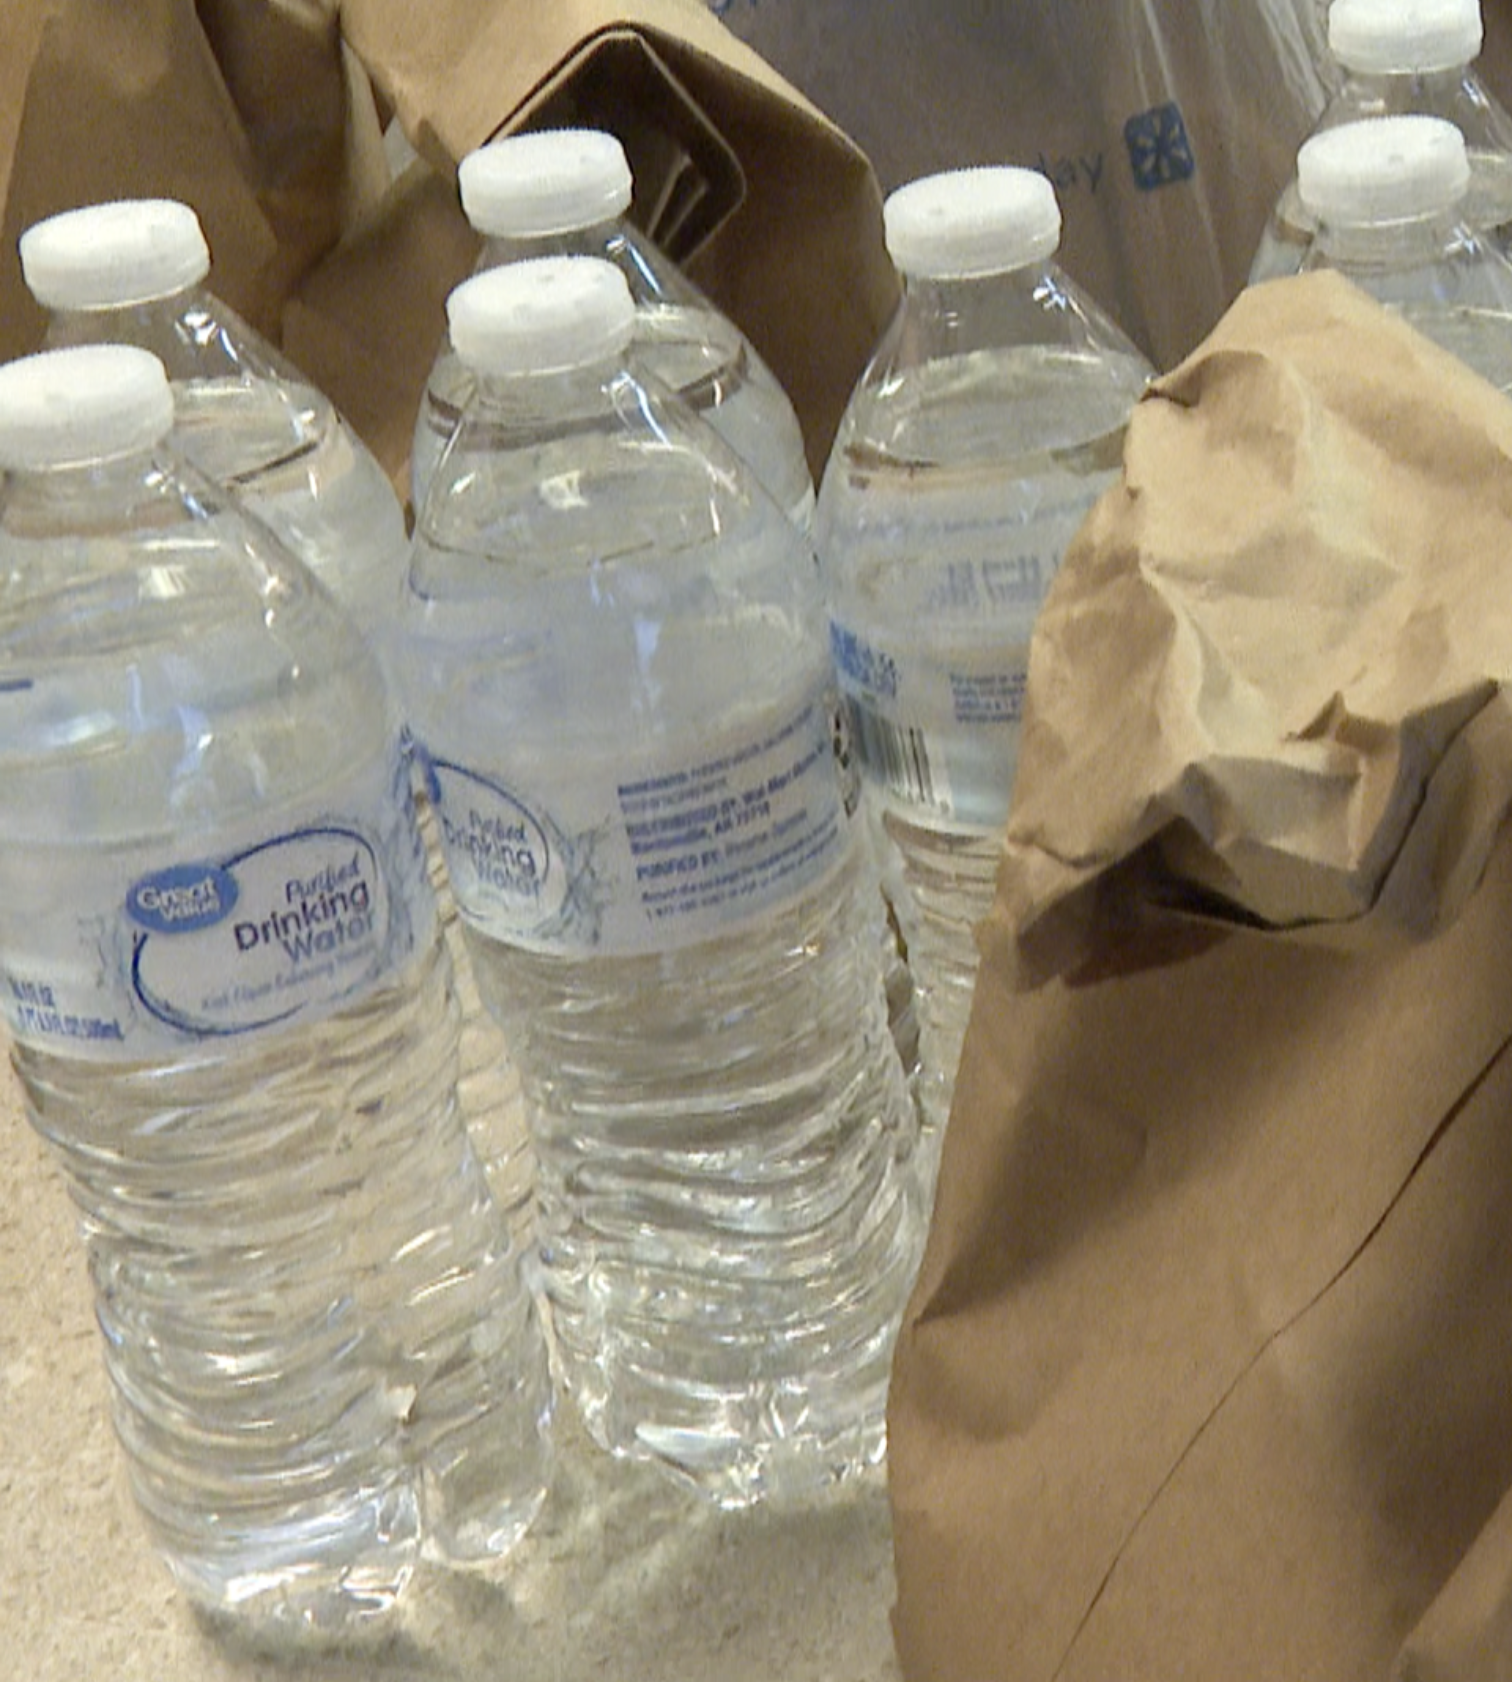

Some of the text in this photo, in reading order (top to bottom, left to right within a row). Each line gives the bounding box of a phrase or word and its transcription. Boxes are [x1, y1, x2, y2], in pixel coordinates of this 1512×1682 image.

[286, 850, 361, 905] Purified
[233, 879, 370, 952] Drinking
[282, 910, 375, 963] Water
